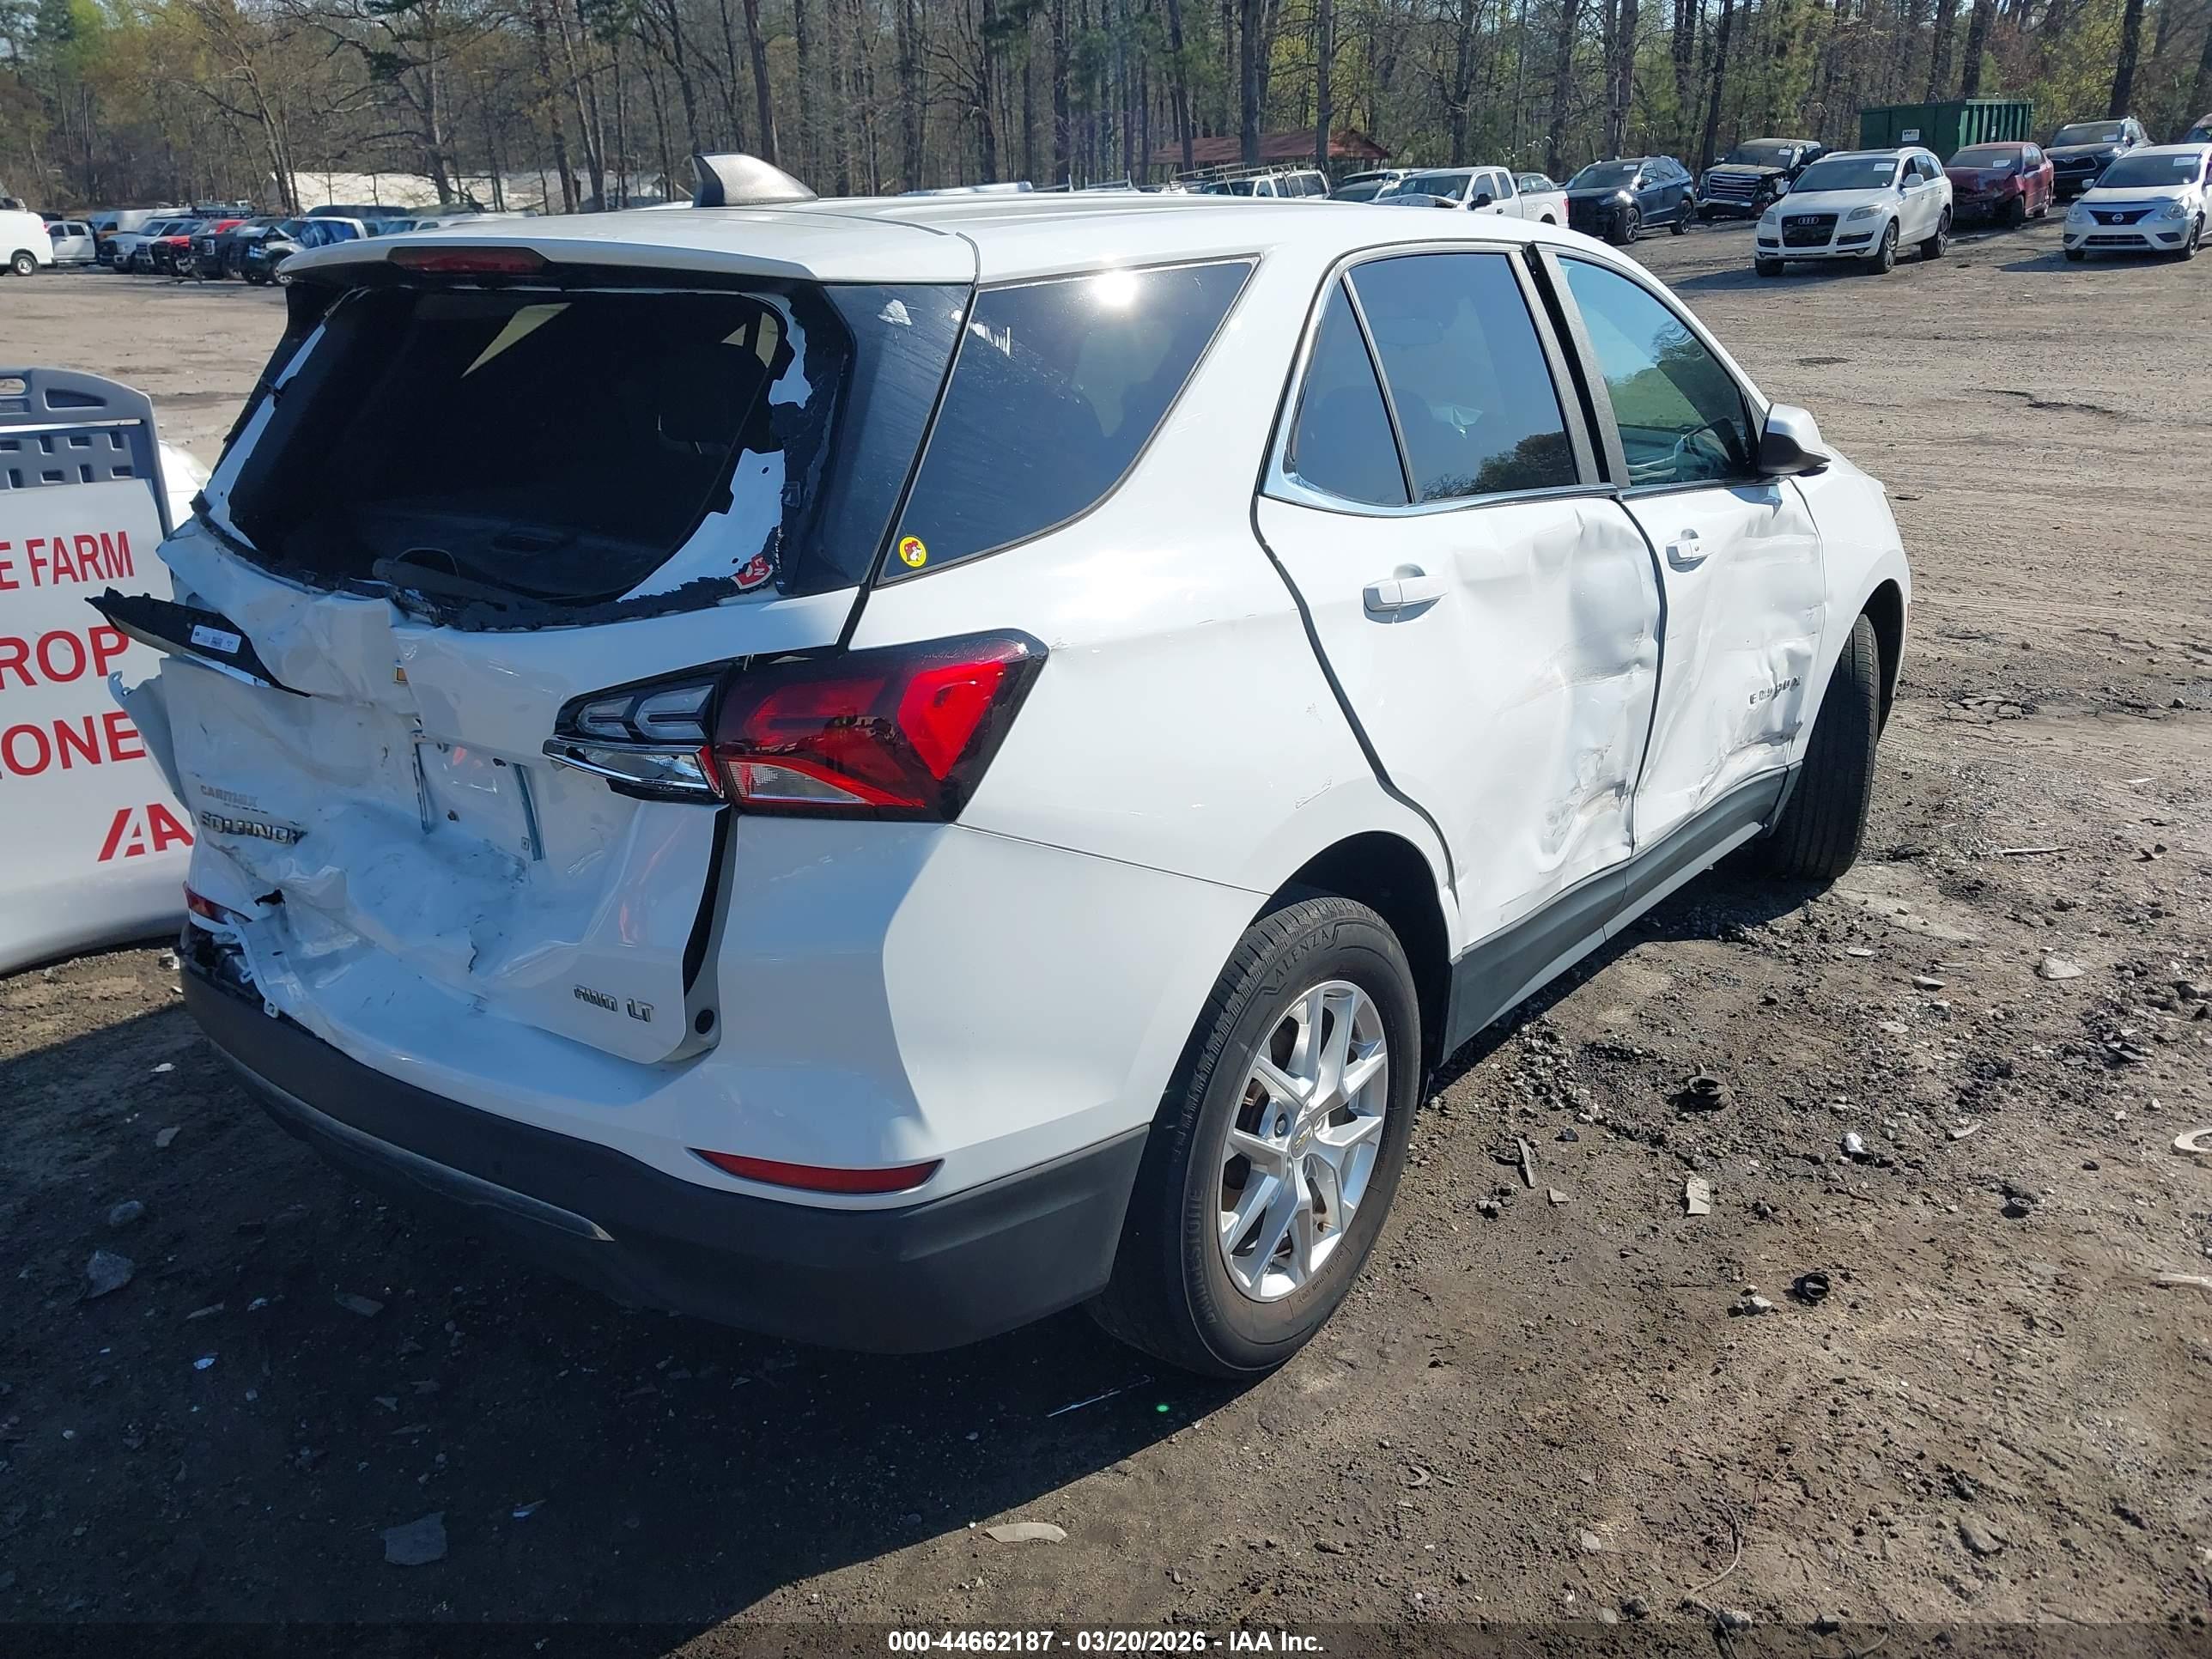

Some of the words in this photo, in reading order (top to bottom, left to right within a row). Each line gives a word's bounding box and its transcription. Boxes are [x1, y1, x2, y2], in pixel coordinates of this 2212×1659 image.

[25, 530, 135, 587] FARM
[0, 711, 147, 780] ONE
[1274, 929, 1329, 983] ALENZA
[573, 983, 619, 1012] AWD
[626, 998, 654, 1023] LT
